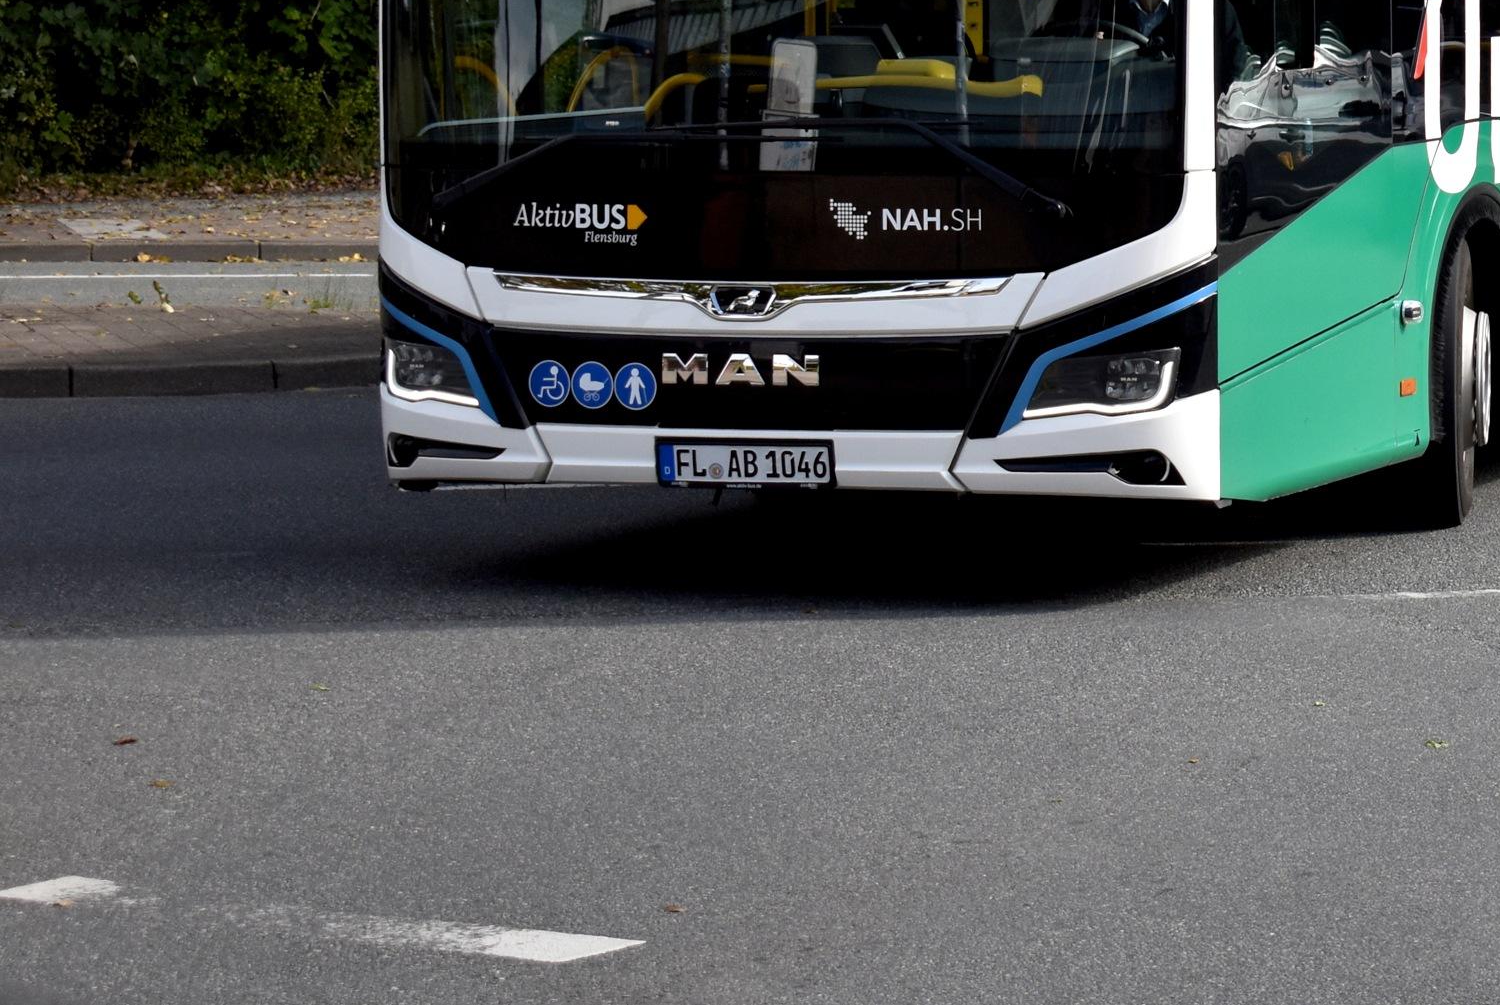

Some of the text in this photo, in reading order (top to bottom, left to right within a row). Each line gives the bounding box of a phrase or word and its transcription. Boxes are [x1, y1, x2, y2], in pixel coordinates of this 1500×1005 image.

[513, 202, 626, 230] AktivBUS
[882, 207, 983, 232] NAH.SH
[584, 230, 638, 247] Flensburg
[661, 352, 820, 387] MAN
[663, 465, 671, 475] D
[675, 449, 828, 479] FL AB 1046
